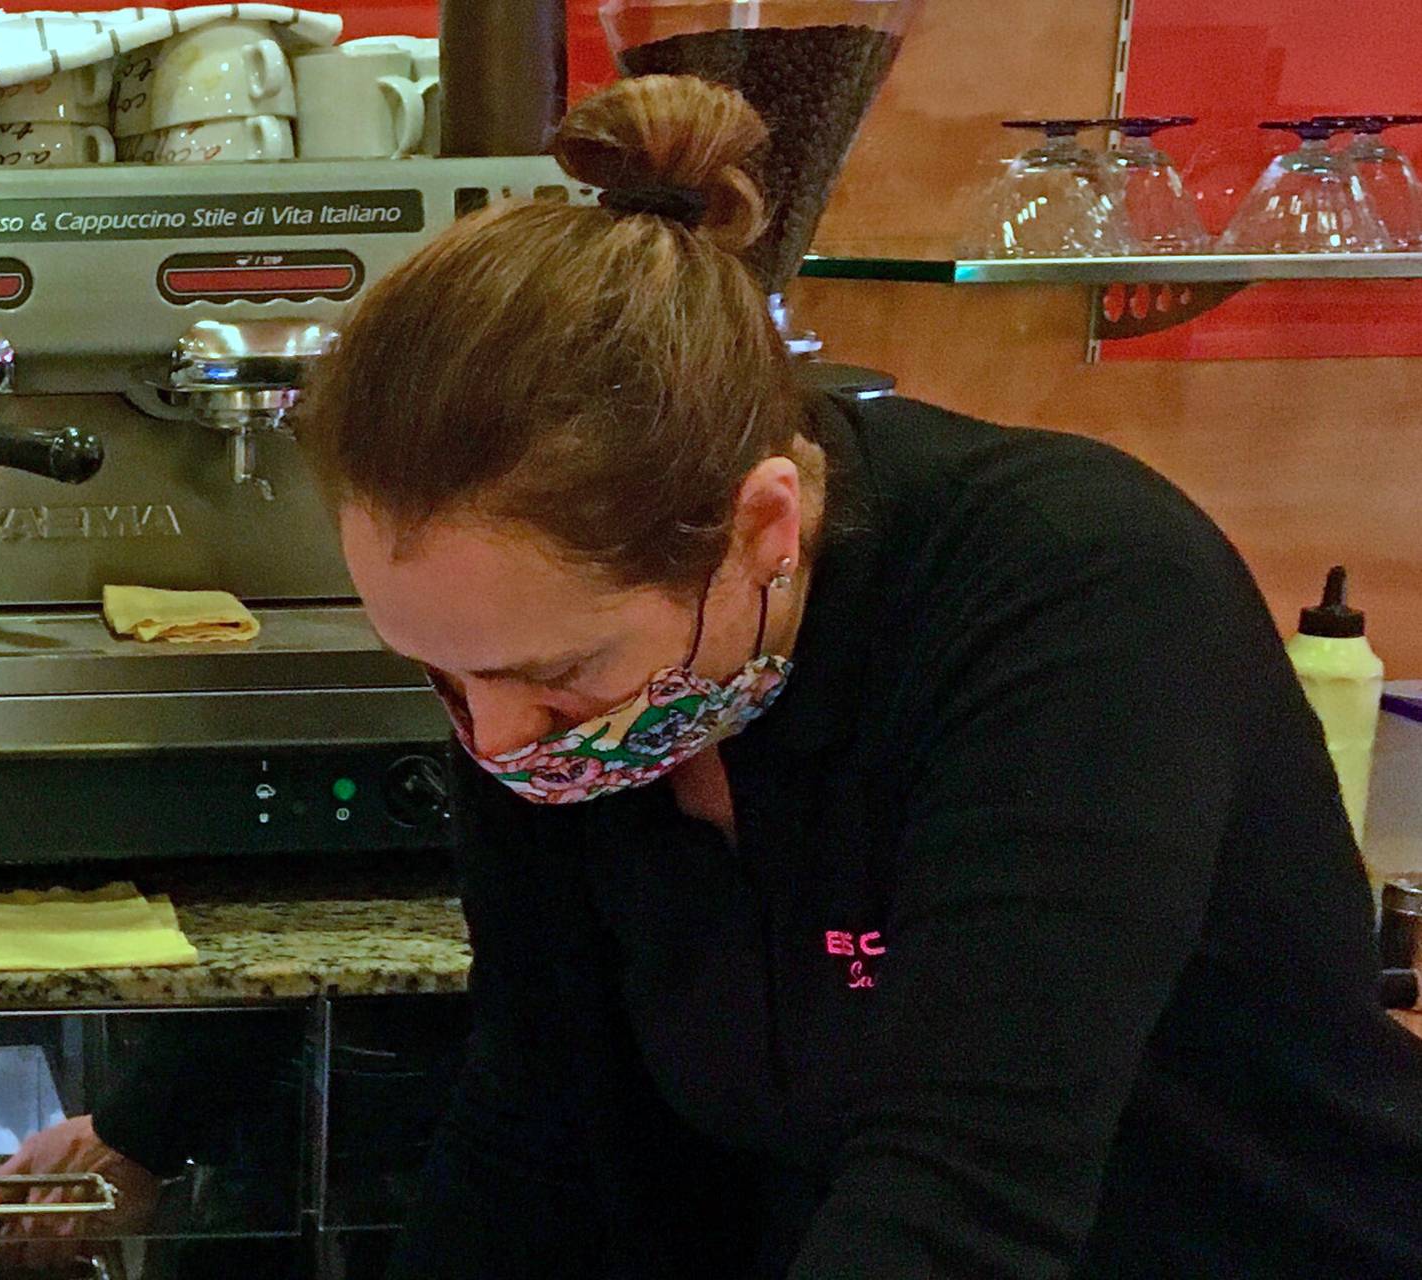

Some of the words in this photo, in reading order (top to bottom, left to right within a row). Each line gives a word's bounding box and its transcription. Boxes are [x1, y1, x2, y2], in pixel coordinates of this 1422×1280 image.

[30, 212, 48, 232] &
[55, 210, 186, 235] Cappuccino
[191, 207, 237, 228] Stile
[242, 206, 265, 226] di
[271, 205, 314, 226] Vita
[319, 203, 402, 224] Italiano
